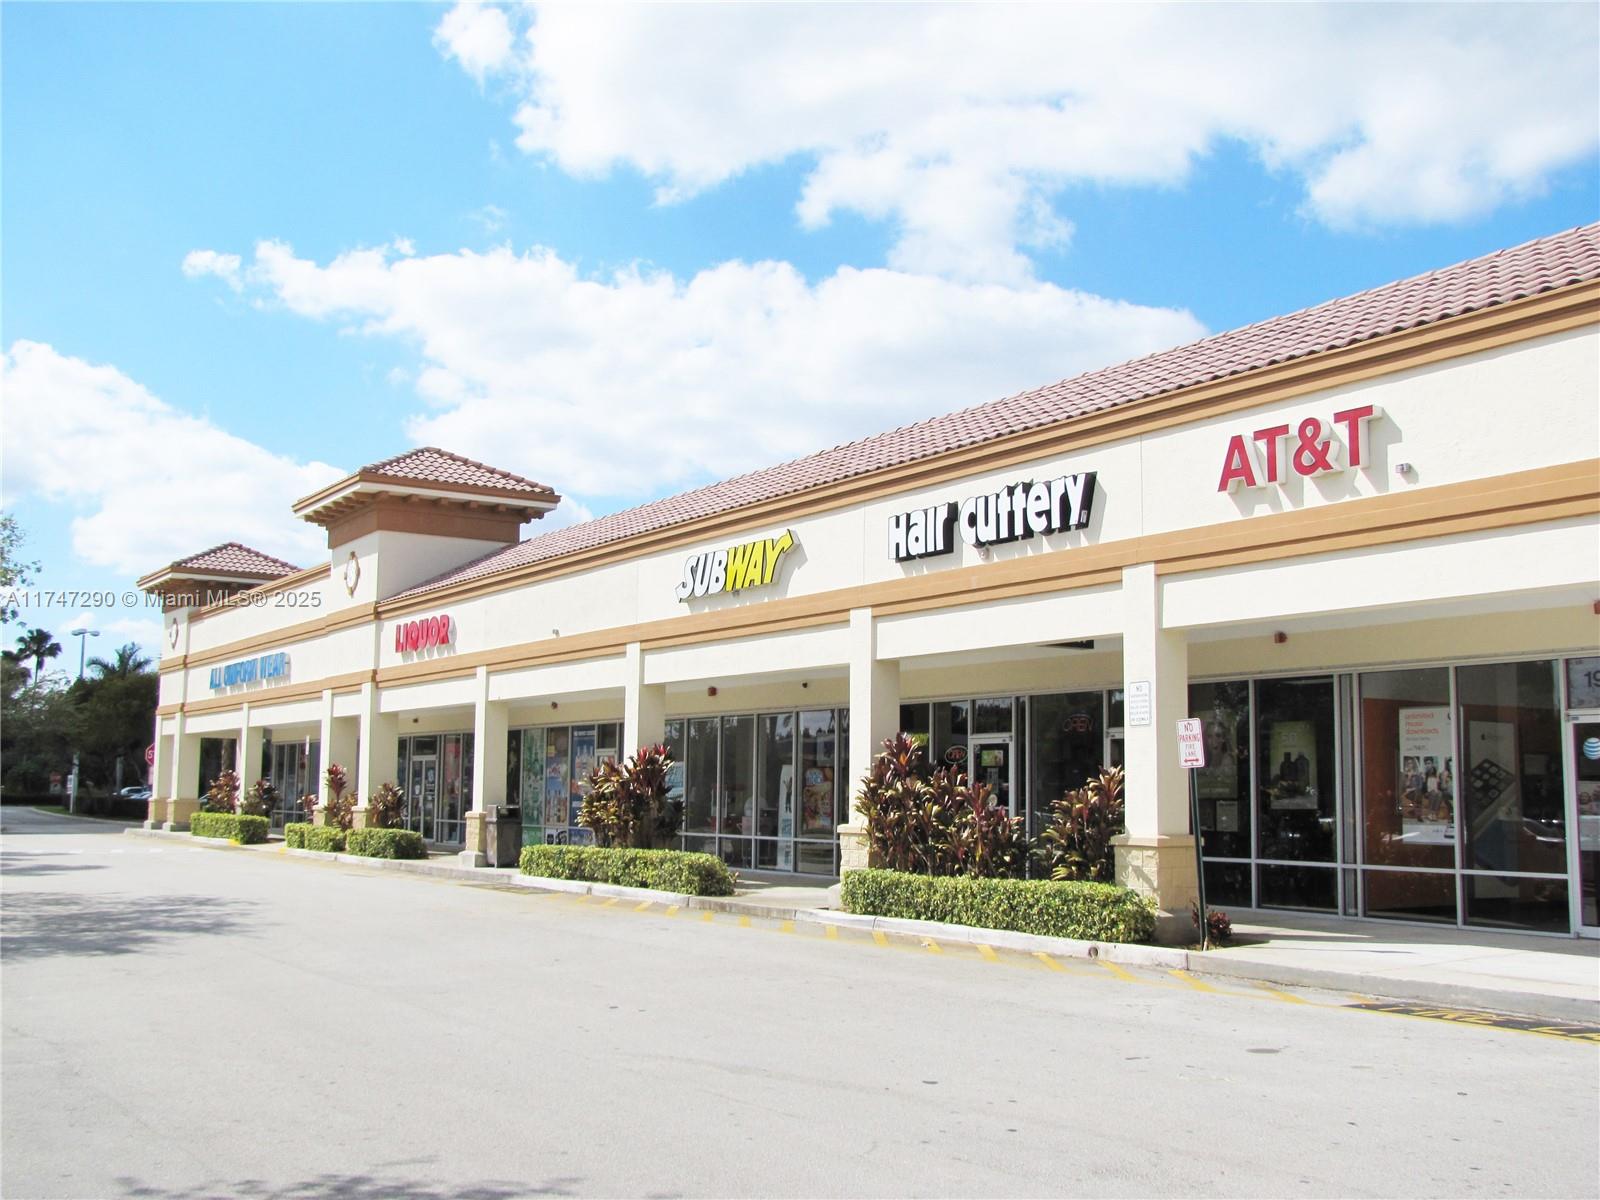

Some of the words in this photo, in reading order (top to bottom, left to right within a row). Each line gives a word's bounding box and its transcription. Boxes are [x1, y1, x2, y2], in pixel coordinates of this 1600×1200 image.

[1218, 404, 1374, 492] AT&T
[888, 502, 952, 560] Hair
[675, 529, 794, 603] SUBWAY
[395, 614, 450, 653] LIQUOR
[1178, 733, 1200, 743] PARKING
[1184, 722, 1194, 733] NO
